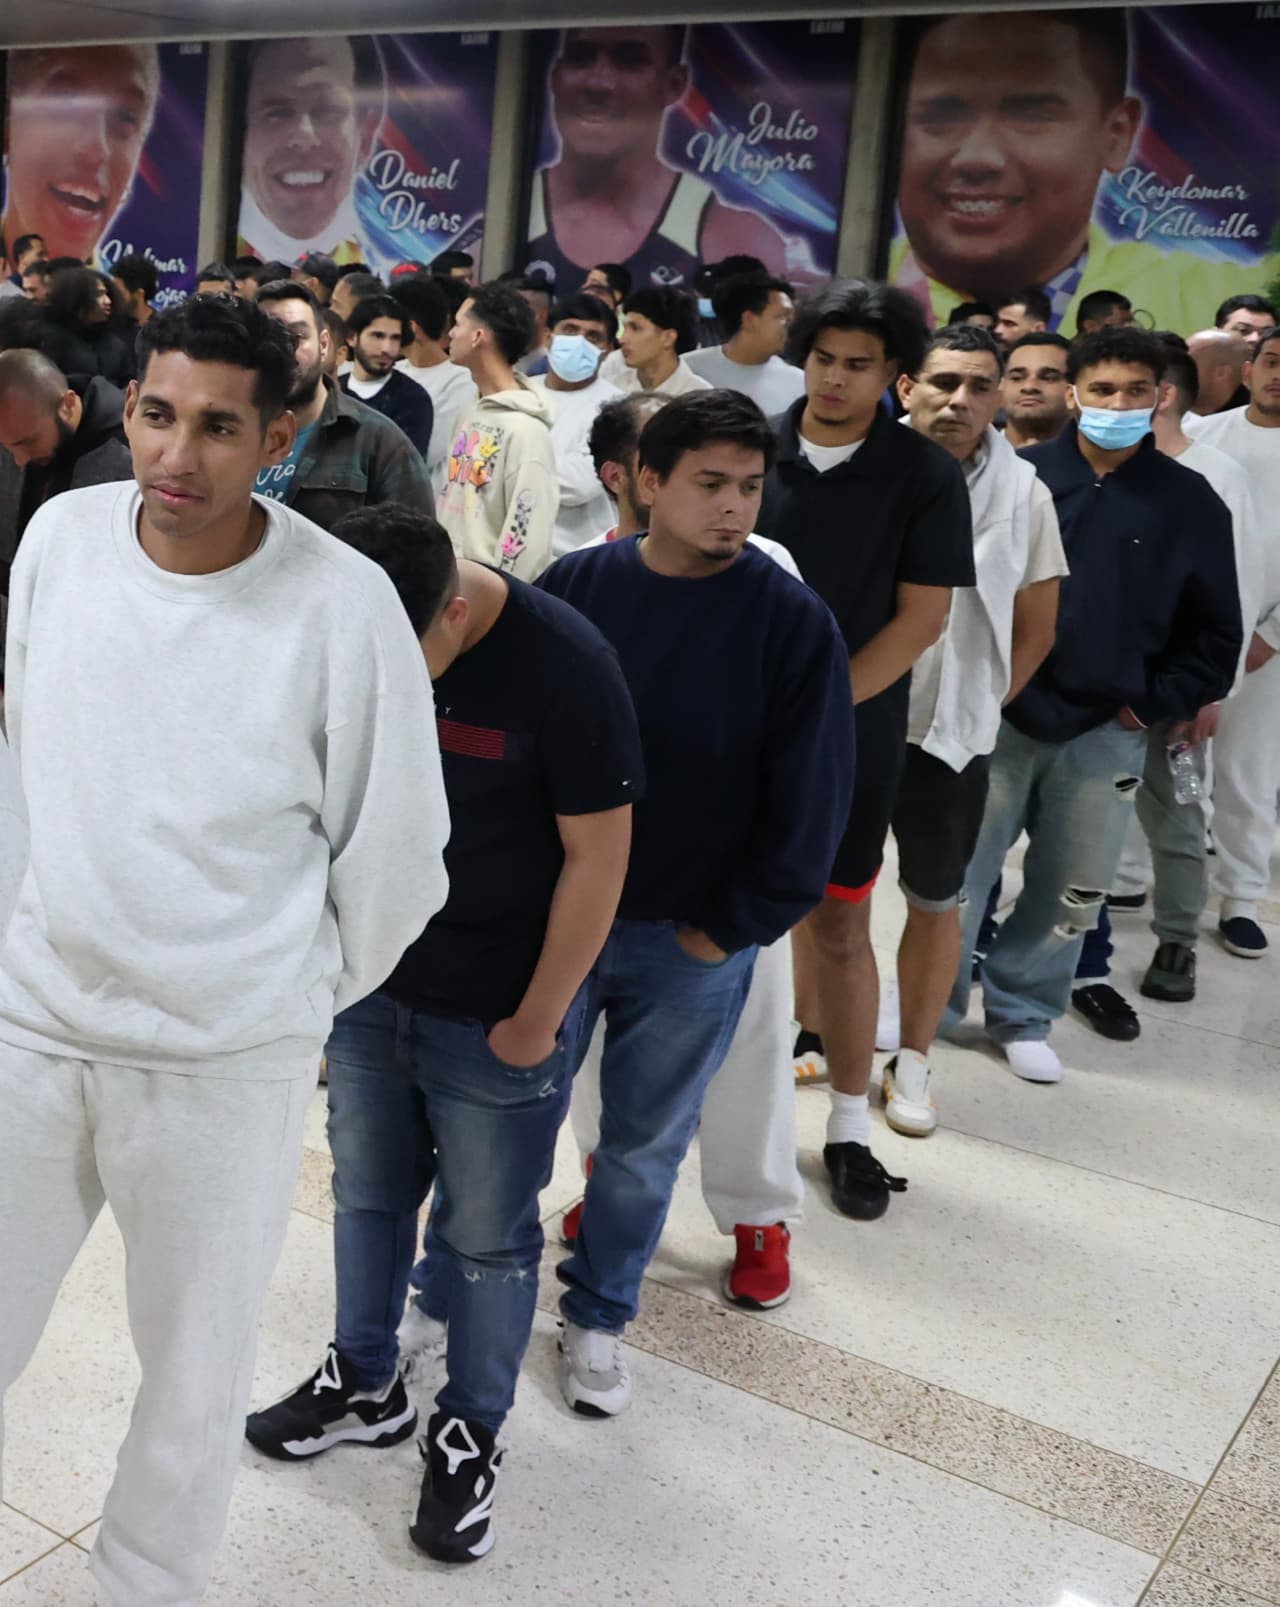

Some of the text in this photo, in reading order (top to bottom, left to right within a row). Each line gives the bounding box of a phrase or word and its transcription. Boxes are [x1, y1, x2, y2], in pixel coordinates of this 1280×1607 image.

[747, 102, 819, 145] Julio
[369, 149, 461, 190] Daniel
[686, 132, 816, 185] Mayora
[1117, 167, 1248, 211] Keydomar
[379, 190, 462, 234] Dhers
[1118, 205, 1260, 240] Vallenilla
[155, 281, 188, 309] ojas
